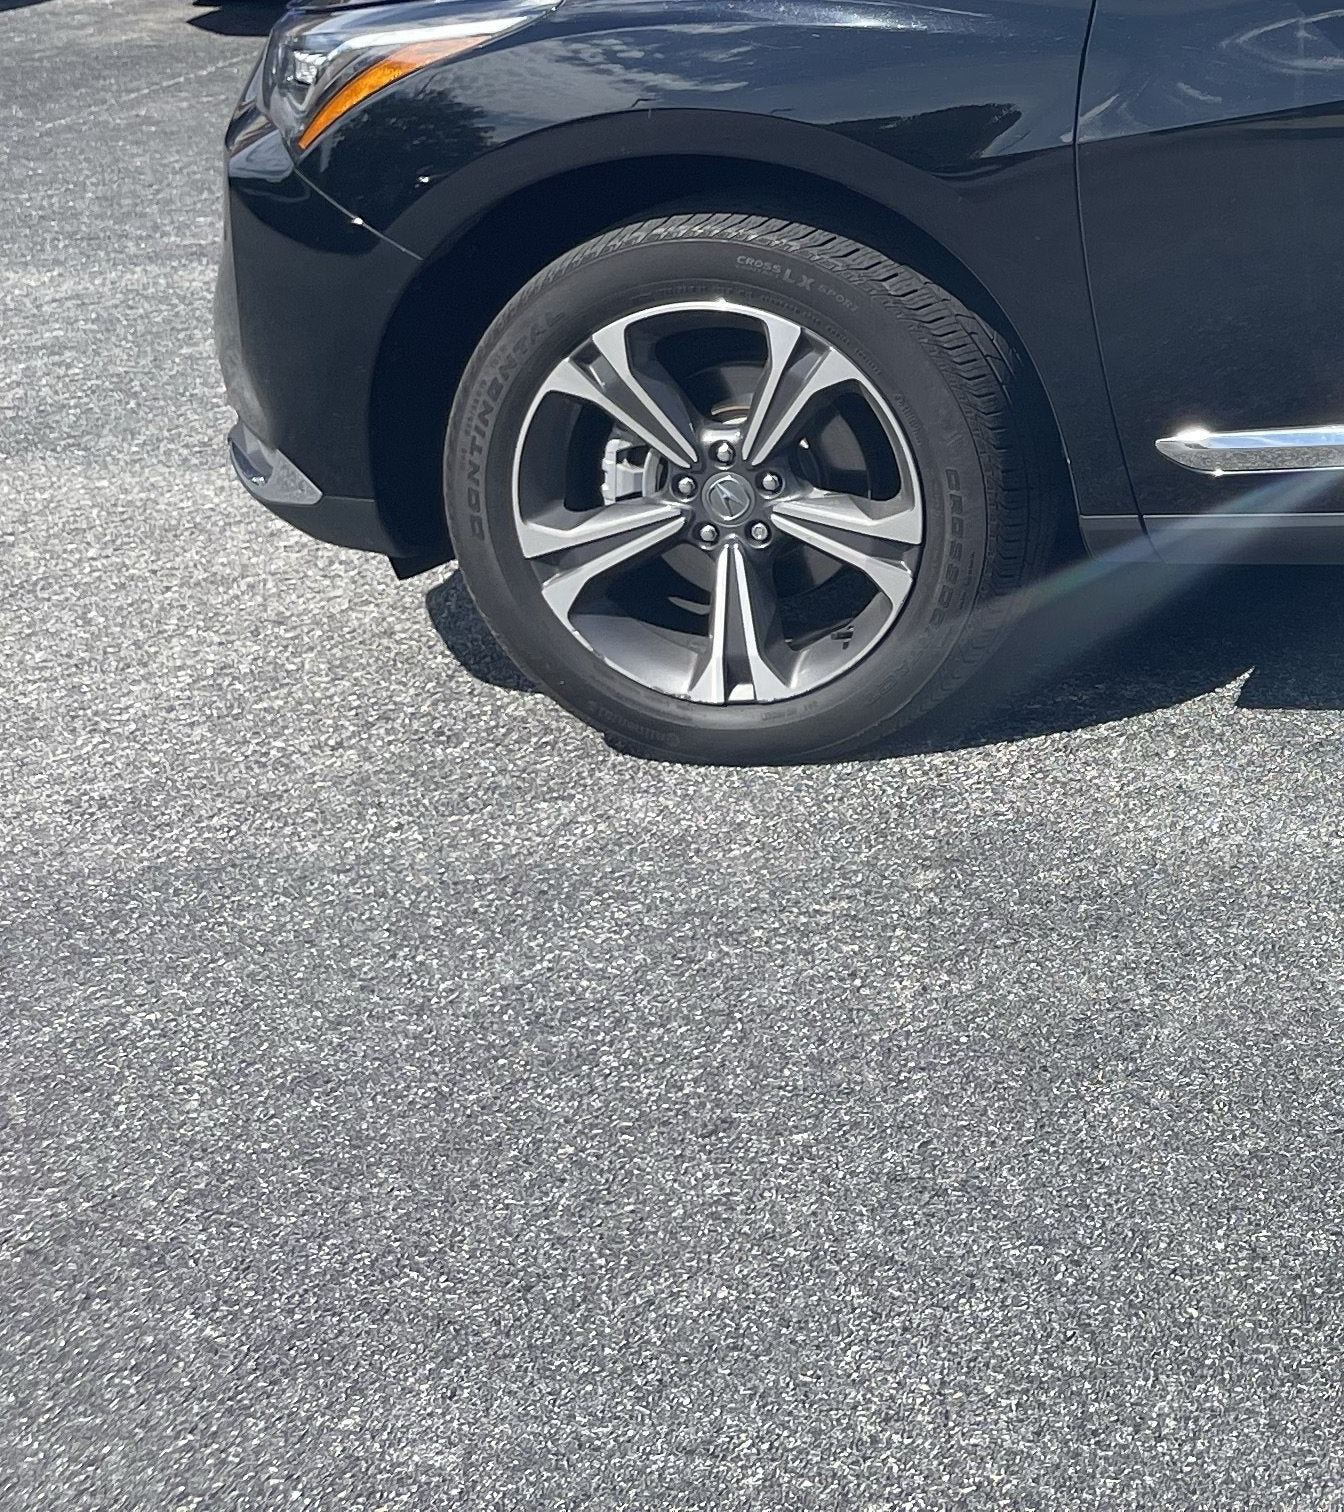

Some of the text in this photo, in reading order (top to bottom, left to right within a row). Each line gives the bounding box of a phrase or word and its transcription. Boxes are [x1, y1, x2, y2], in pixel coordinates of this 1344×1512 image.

[736, 255, 781, 273] CROSS
[818, 285, 859, 312] SPORT
[466, 311, 565, 541] CONTINENTAL
